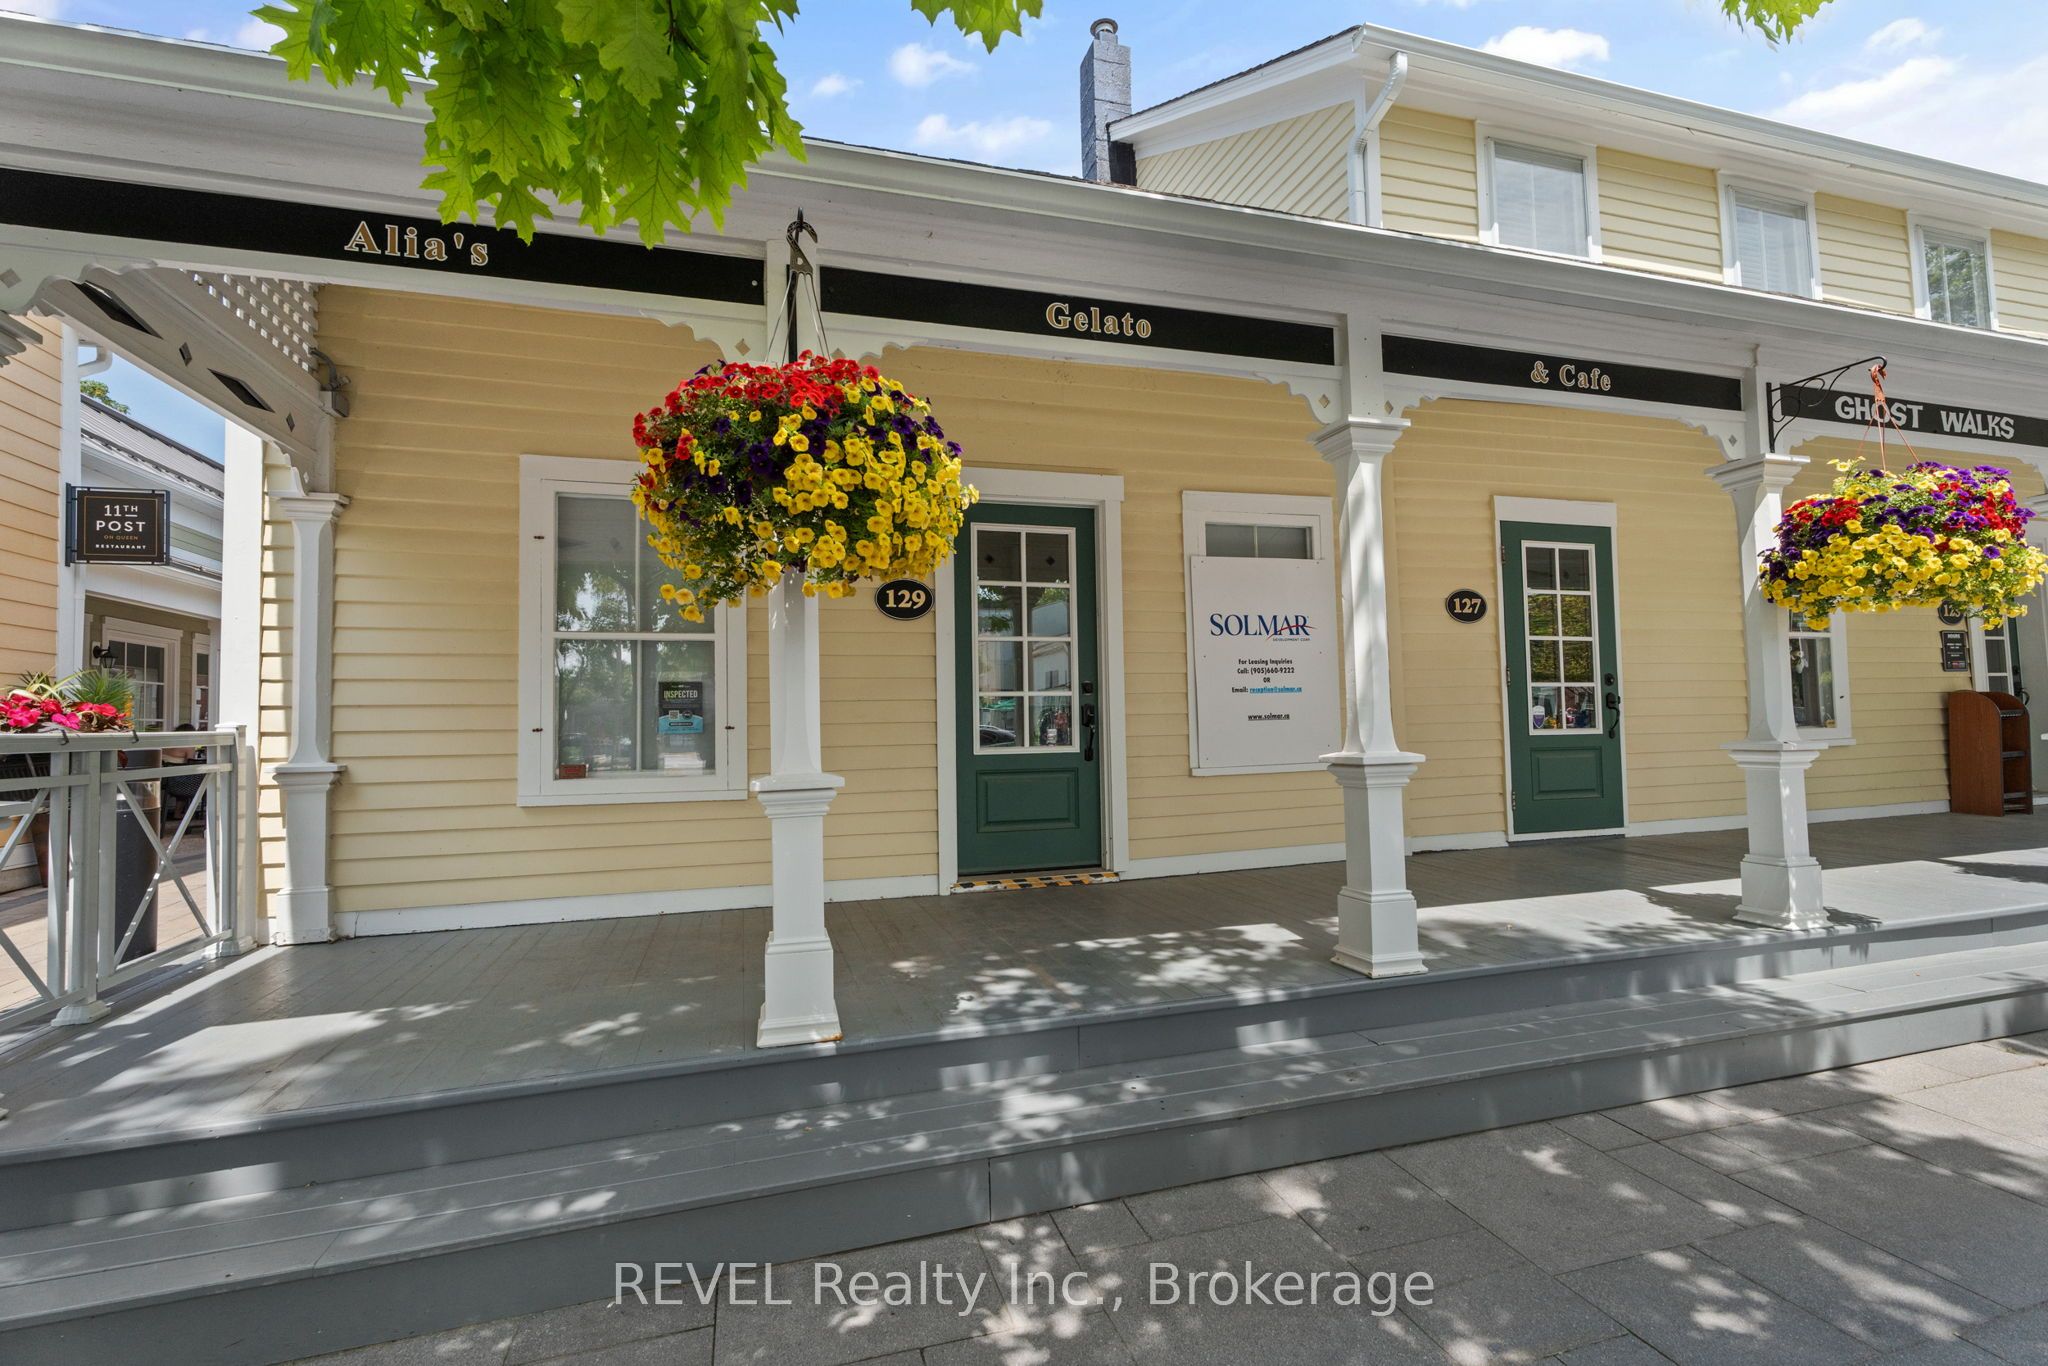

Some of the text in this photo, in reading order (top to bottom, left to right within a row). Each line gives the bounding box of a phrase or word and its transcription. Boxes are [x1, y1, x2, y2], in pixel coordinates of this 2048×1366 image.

[344, 220, 488, 266] Alia's
[1046, 302, 1151, 338] Gelato
[1530, 360, 1611, 391] & Cafe
[1834, 395, 2015, 440] GHOST WALKS
[96, 520, 146, 532] POST
[885, 589, 926, 609] 129
[1453, 597, 1482, 615] 127
[1210, 613, 1310, 636] SOLMAR
[1250, 667, 1295, 675] (905)660-9222
[1269, 658, 1293, 666] Inquiries
[663, 690, 698, 698] INSPECTED
[1248, 713, 1290, 721] www.solmar.ca
